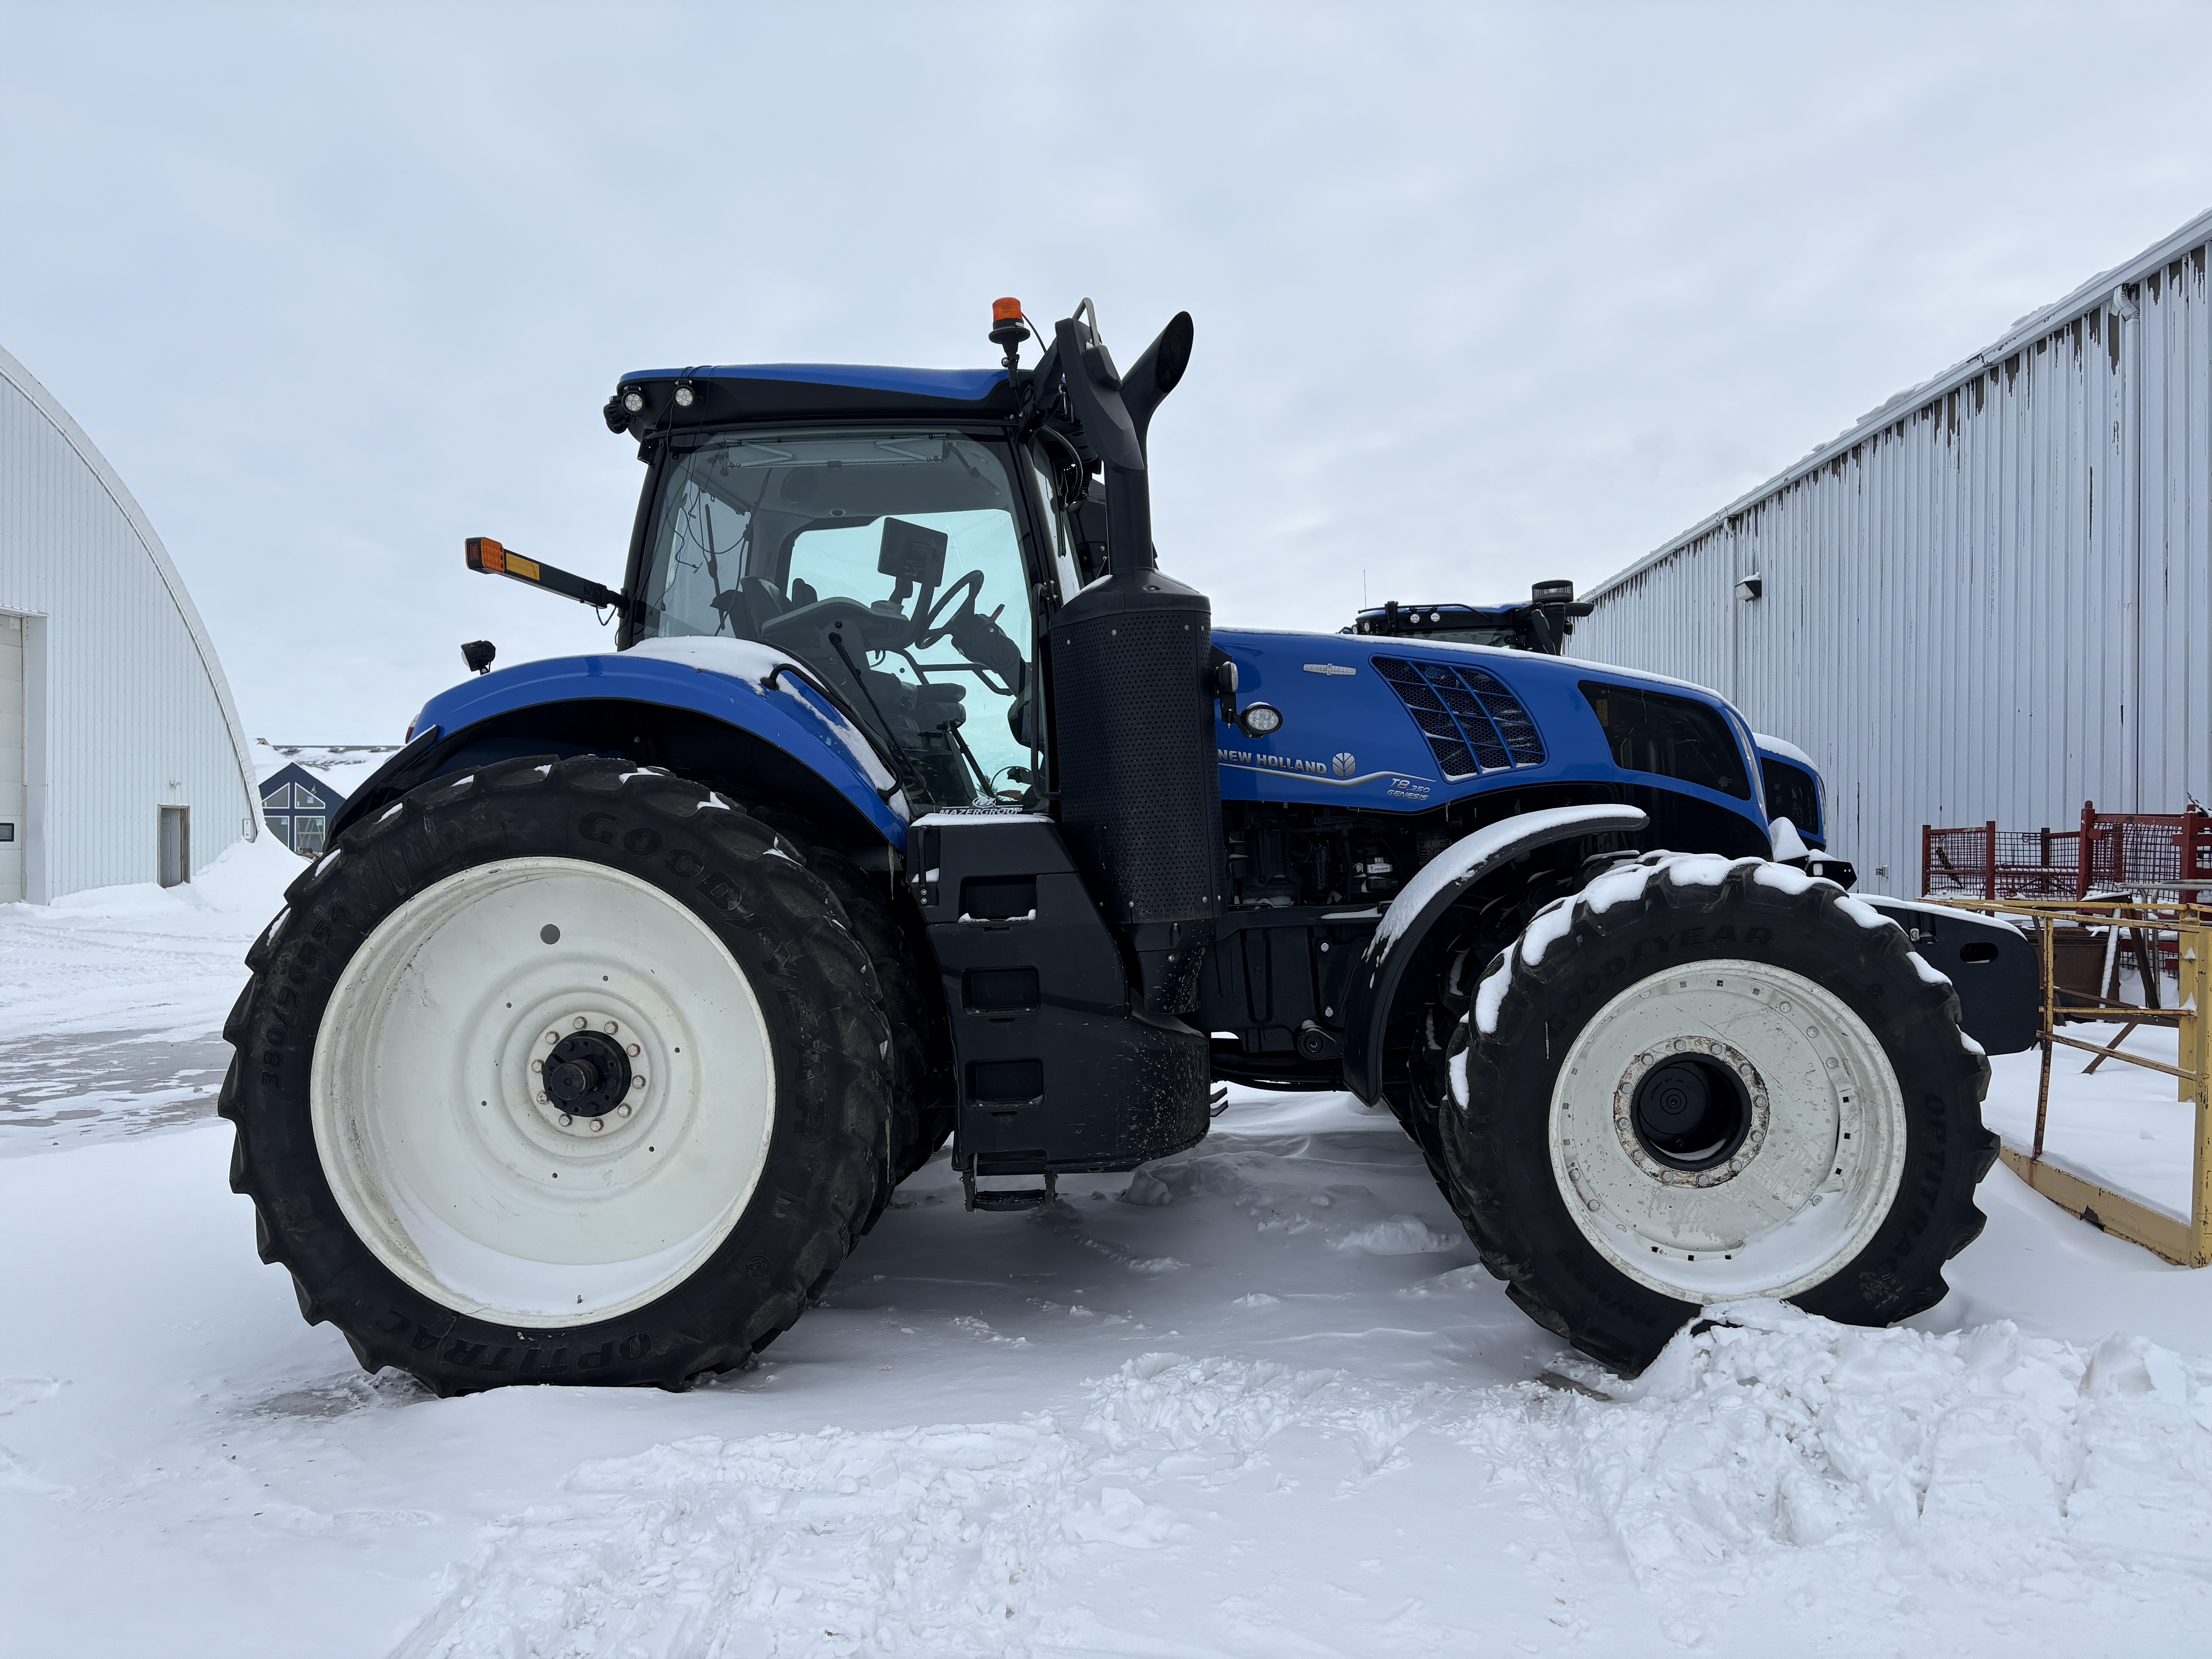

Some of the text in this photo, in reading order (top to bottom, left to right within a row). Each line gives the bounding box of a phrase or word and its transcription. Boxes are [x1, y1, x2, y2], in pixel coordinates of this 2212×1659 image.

[1218, 749, 1327, 775] NEW HOLLAND
[1387, 790, 1429, 800] GENESIS
[261, 900, 348, 1089] 380/90R54
[1549, 925, 1773, 1039] GOODYEAR
[375, 1309, 654, 1376] OPTITRAC
